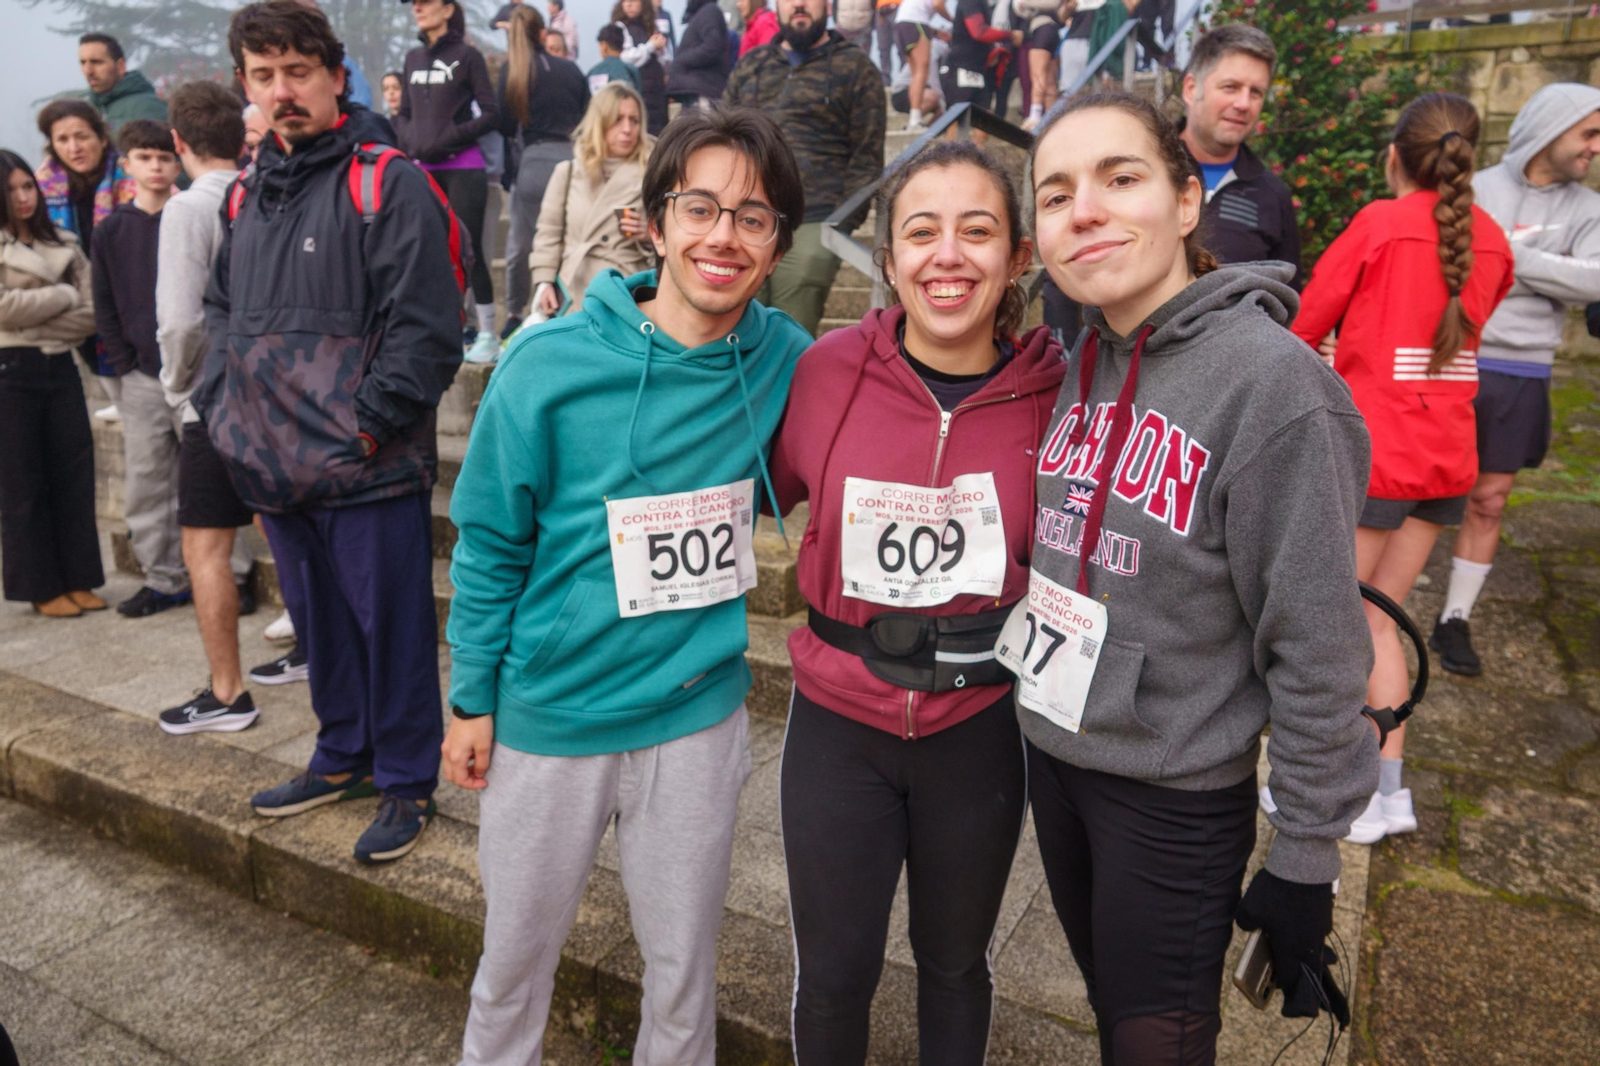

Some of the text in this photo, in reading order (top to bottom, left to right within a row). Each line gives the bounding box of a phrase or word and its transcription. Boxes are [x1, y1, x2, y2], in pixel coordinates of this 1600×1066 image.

[647, 490, 730, 512] CORREMOS
[857, 491, 984, 516] CONTRA O CACRO
[881, 486, 956, 505] CORREM
[622, 510, 683, 526] CONTRA
[686, 508, 697, 519] O
[917, 515, 949, 525] FEBREIR
[955, 506, 974, 515] 2026
[647, 522, 736, 581] 502
[877, 518, 965, 576] 609
[1030, 591, 1093, 630] O CANCRO
[1052, 618, 1061, 627] DE
[1061, 622, 1078, 635] 2026
